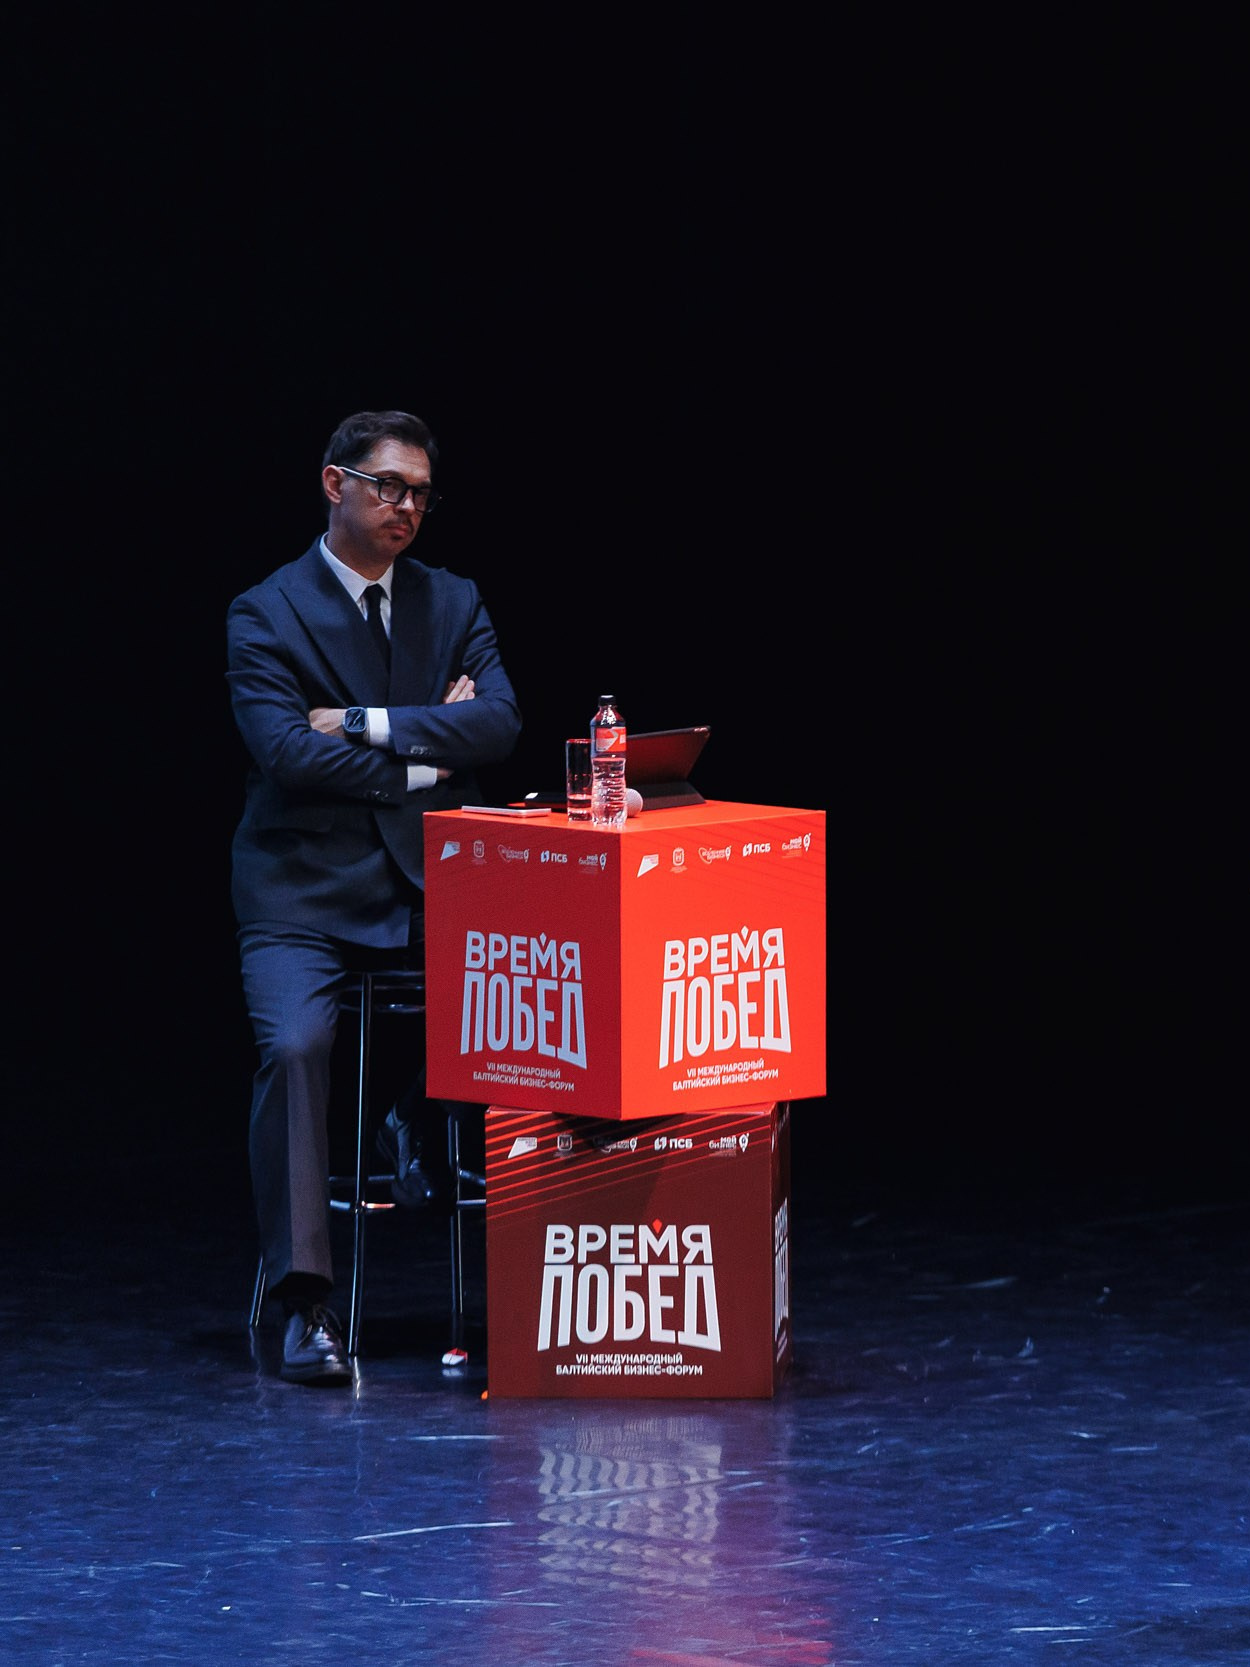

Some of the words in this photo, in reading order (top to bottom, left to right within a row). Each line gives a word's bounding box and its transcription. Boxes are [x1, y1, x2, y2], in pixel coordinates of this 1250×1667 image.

[551, 853, 567, 863] ПСБ
[754, 843, 771, 854] ПСБ
[465, 930, 582, 981] ВРЕМЯ
[663, 927, 785, 981] ВРЕМЯ
[460, 971, 587, 1070] ПОБЕД
[659, 967, 792, 1070] ПОБЕД
[486, 1061, 496, 1071] VII
[496, 1063, 561, 1079] МЕЖДУНАРОДНЫЙ
[687, 1067, 697, 1078] VII
[697, 1058, 764, 1077] МЕЖДУНАРОДНЫЙ
[473, 1071, 519, 1085] БАЛТИЙСКИЙ
[519, 1078, 575, 1092] БИЗНЕС-ФОРУМ
[672, 1076, 720, 1091] БАЛТИЙСКИЙ
[722, 1068, 779, 1085] БИЗНЕС-ФОРУМ
[669, 1137, 693, 1149] ПСБ
[544, 1223, 713, 1265] ВРЕМЯ
[537, 1264, 722, 1352] ПОБЕД
[575, 1353, 588, 1364] VII
[590, 1352, 683, 1365] МЕЖДУНАРОДНЫЙ
[556, 1364, 622, 1376] БАЛТИЙСКИЙ
[624, 1364, 703, 1376] БИЗНЕС-ФОРУМ
